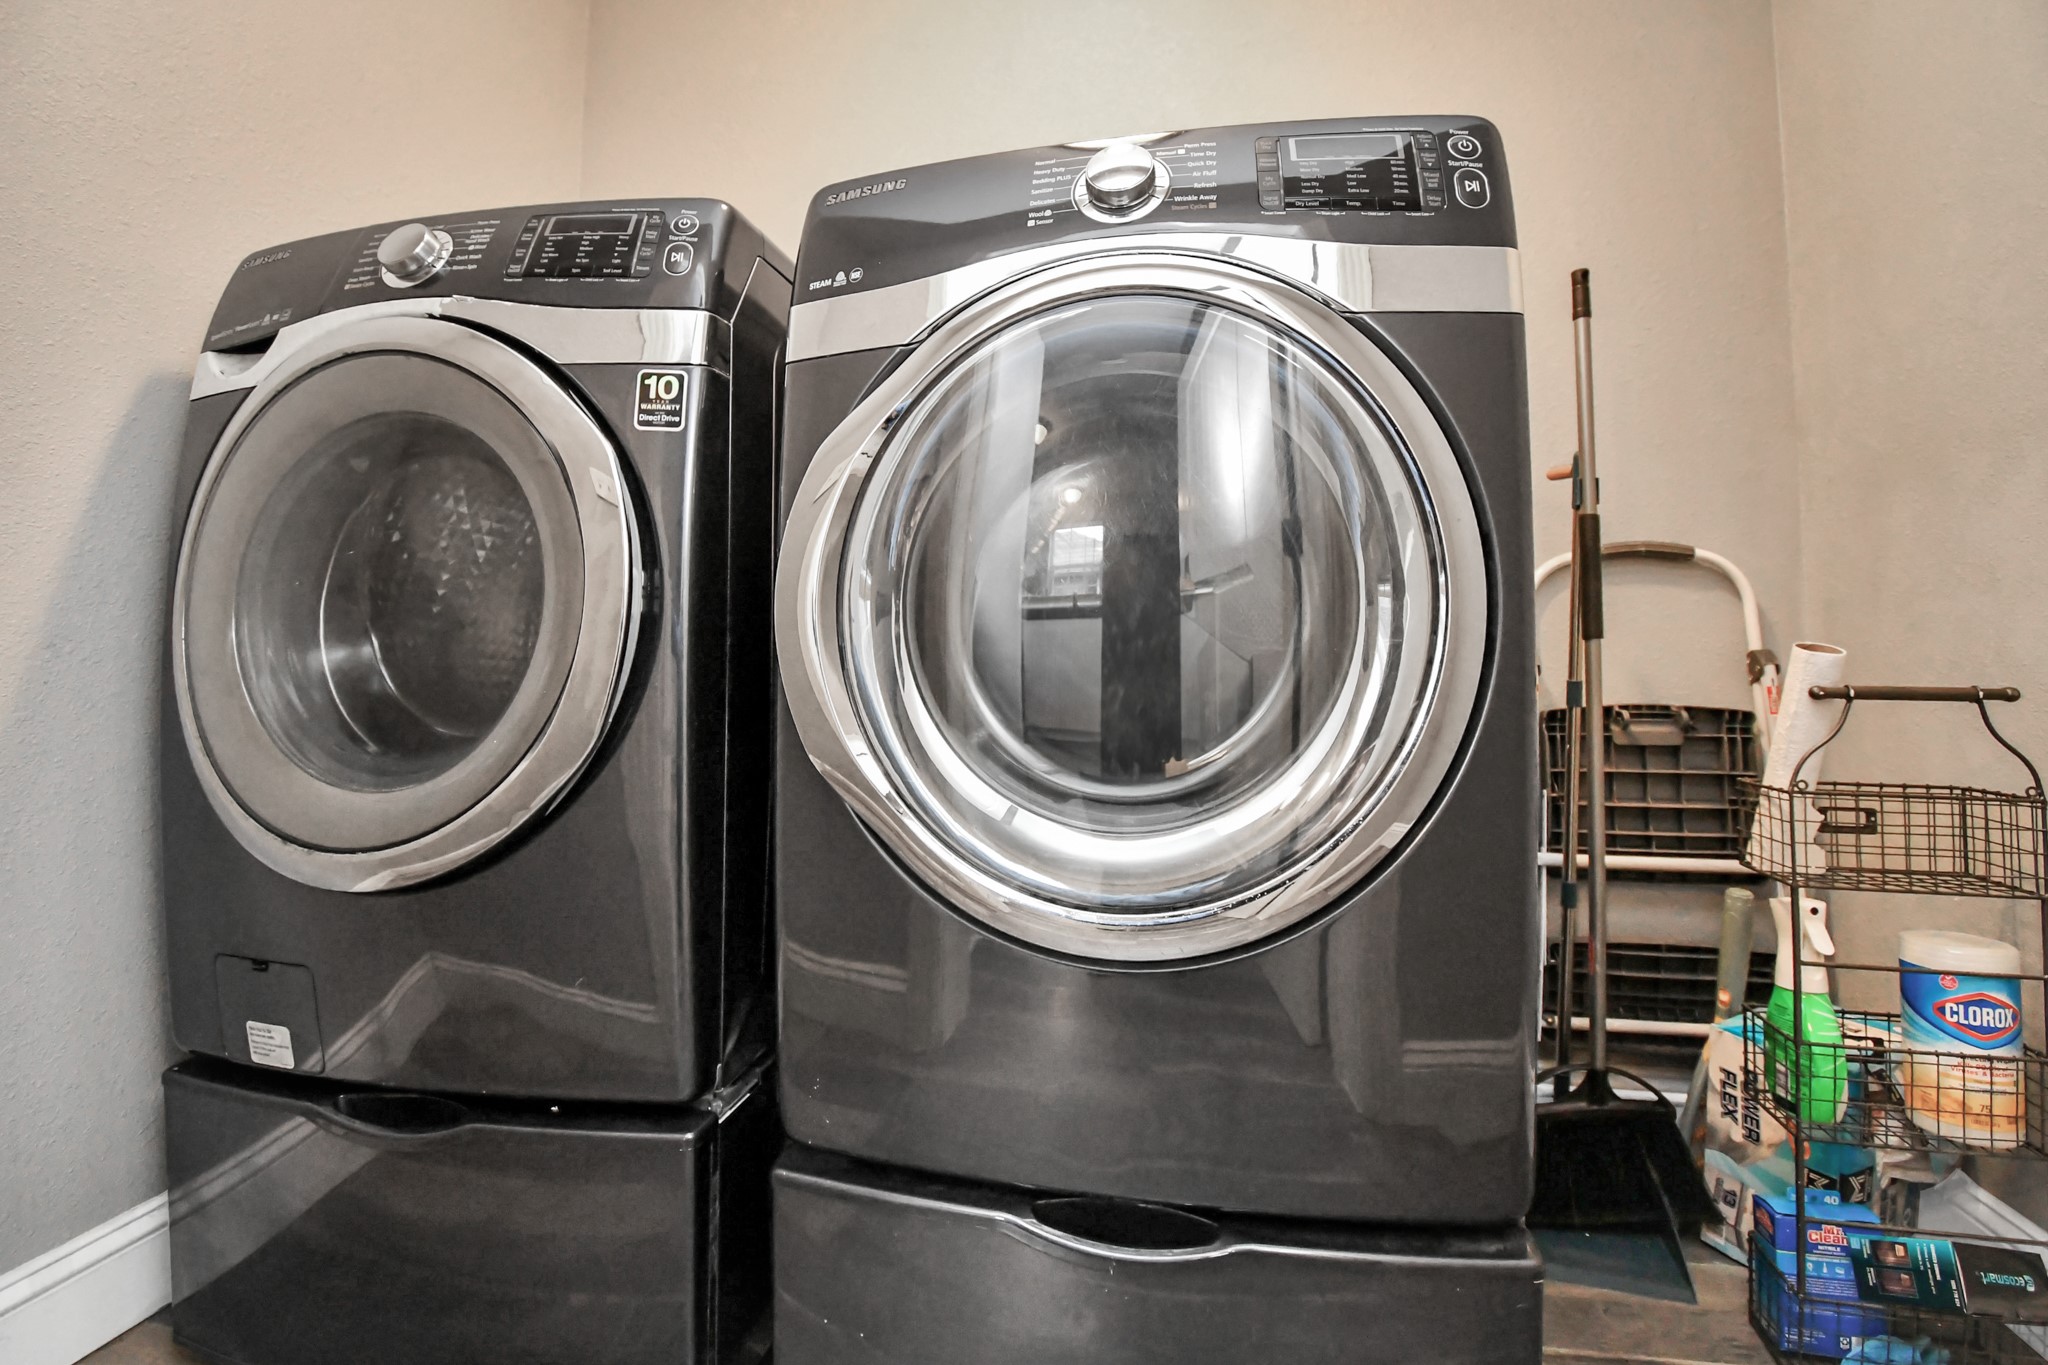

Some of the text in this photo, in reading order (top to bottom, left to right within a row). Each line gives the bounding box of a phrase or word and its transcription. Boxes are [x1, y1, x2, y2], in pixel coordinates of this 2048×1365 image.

[1035, 158, 1056, 166] Normal
[1448, 160, 1483, 168] Start/Pause
[1032, 177, 1055, 185] Bedding
[825, 179, 907, 206] SAMSUNG
[242, 250, 292, 270] SAMSUNG
[809, 279, 832, 290] STEAM
[644, 375, 680, 400] 10
[661, 414, 680, 422] Drive
[1945, 1002, 2014, 1028] CLOROX
[1720, 1066, 1738, 1126] FLEX
[1740, 1066, 1760, 1146] POWER
[1980, 1104, 1992, 1114] 75
[1824, 1195, 1839, 1205] 40
[1822, 1224, 1844, 1236] Mr.
[1808, 1230, 1849, 1246] Clean
[1980, 1272, 2026, 1288] ecosmart
